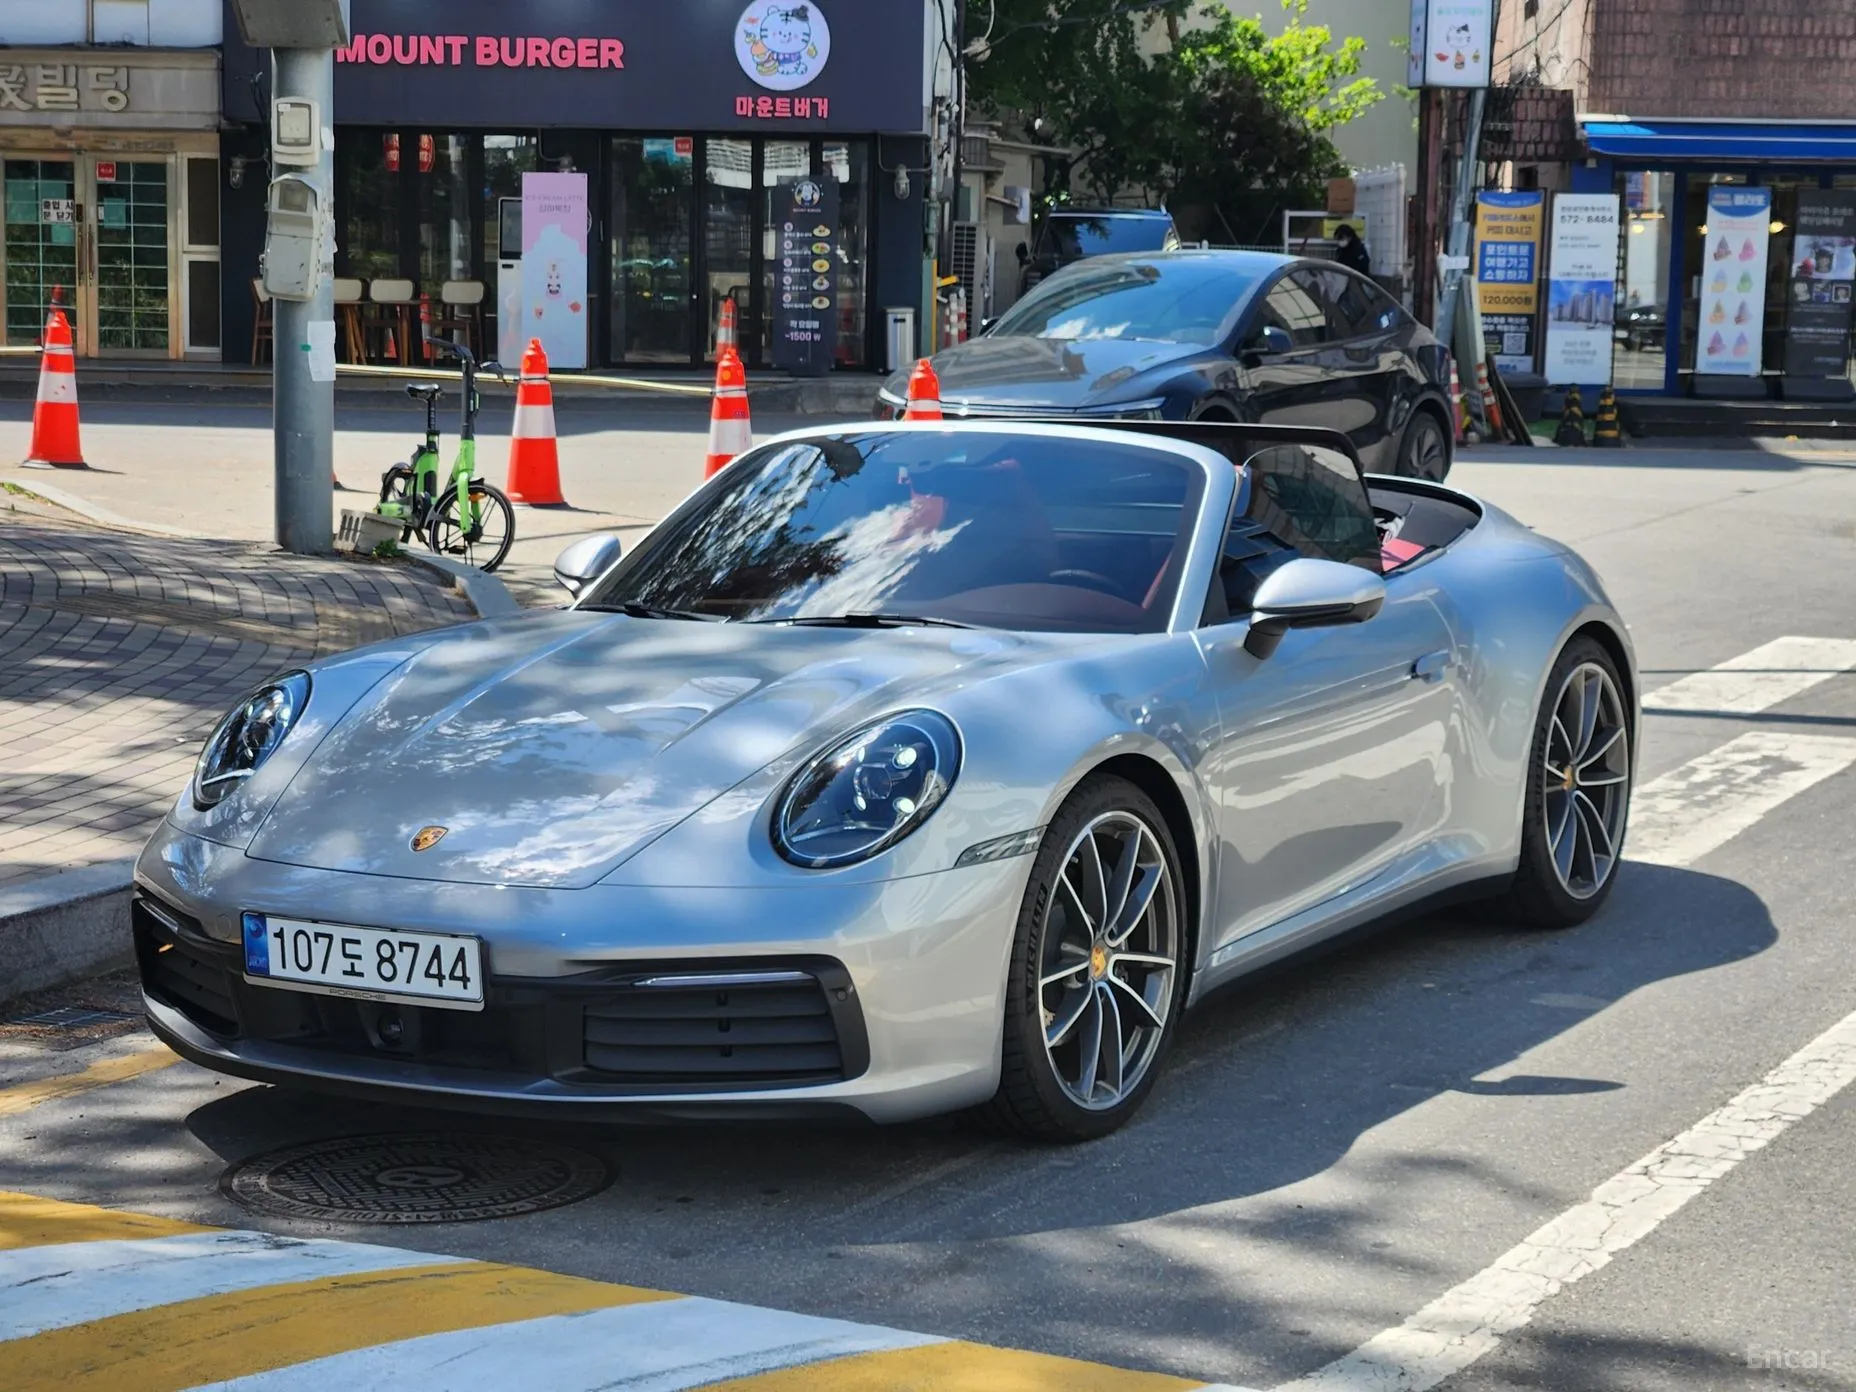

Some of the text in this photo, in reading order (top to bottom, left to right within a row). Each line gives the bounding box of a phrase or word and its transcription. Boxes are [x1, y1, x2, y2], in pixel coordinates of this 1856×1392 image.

[337, 34, 624, 69] MOUNT BURGER
[736, 96, 829, 119] 마운트버거
[1484, 257, 1529, 268] 여행가고
[376, 938, 471, 990] 8744
